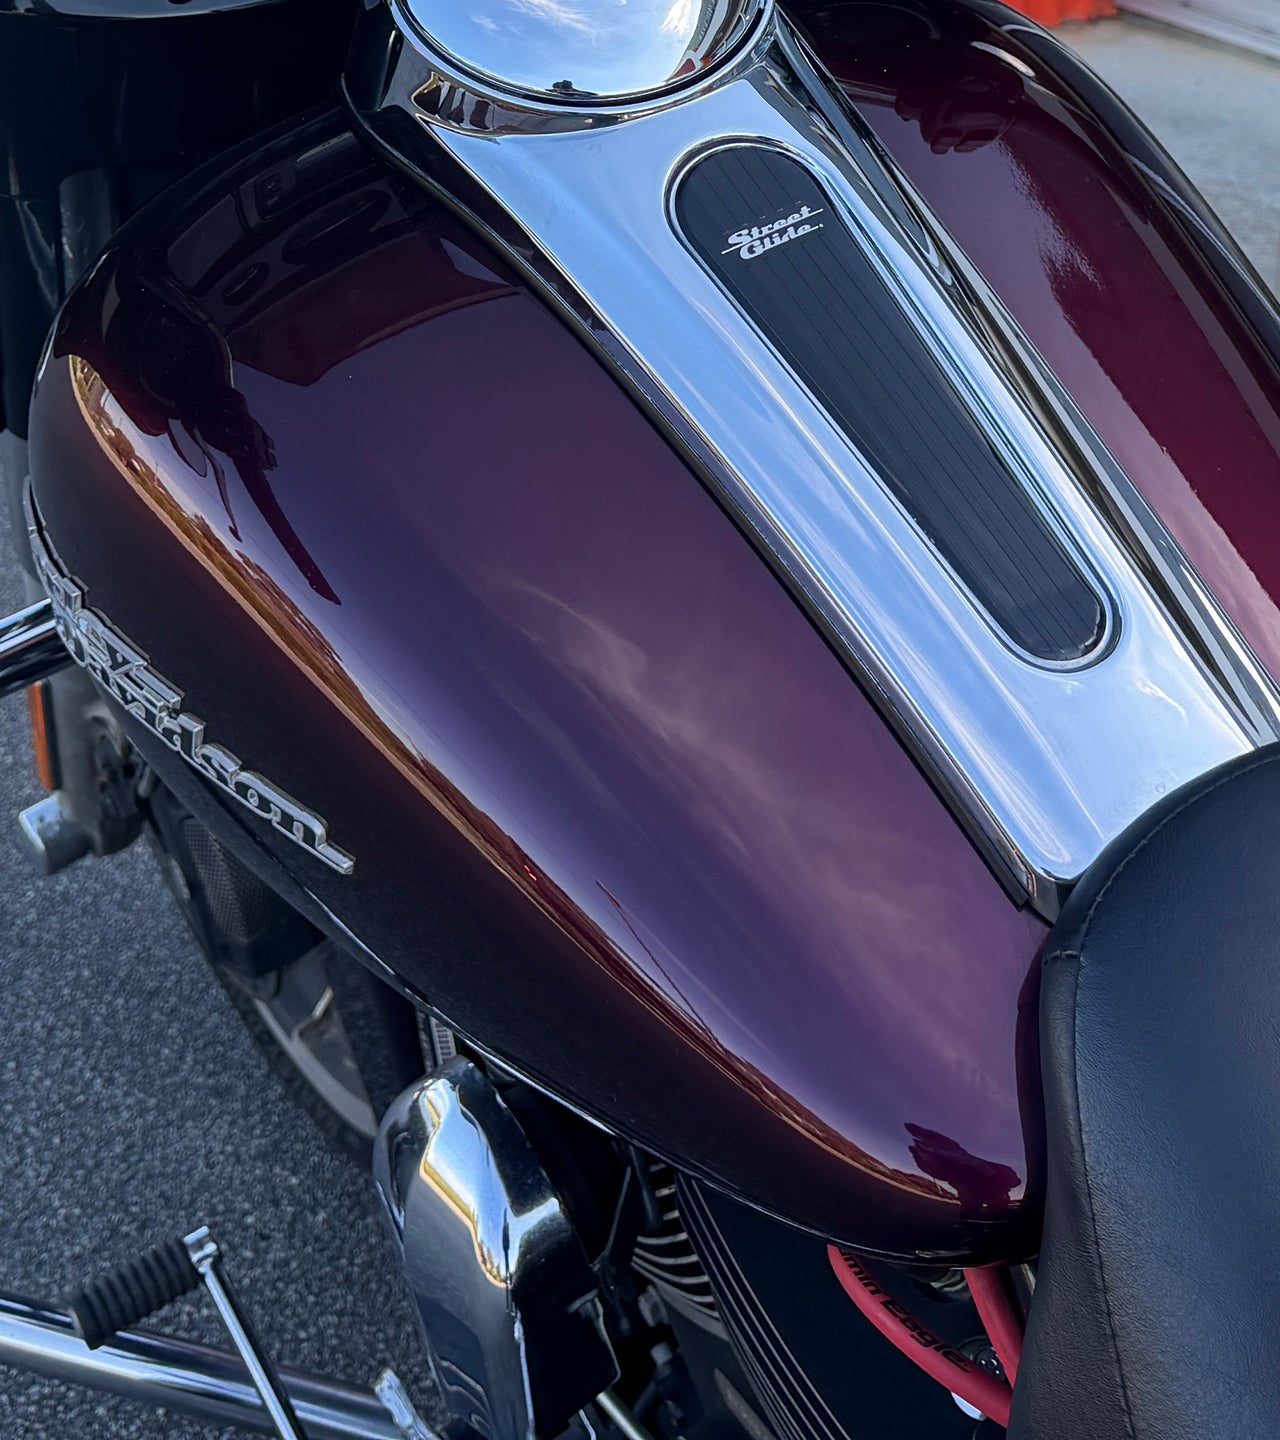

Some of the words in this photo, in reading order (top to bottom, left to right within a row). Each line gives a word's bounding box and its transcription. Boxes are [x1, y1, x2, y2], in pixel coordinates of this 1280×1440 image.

[727, 205, 811, 245] Street
[739, 224, 812, 260] Glide
[879, 1296, 971, 1375] Eagle
